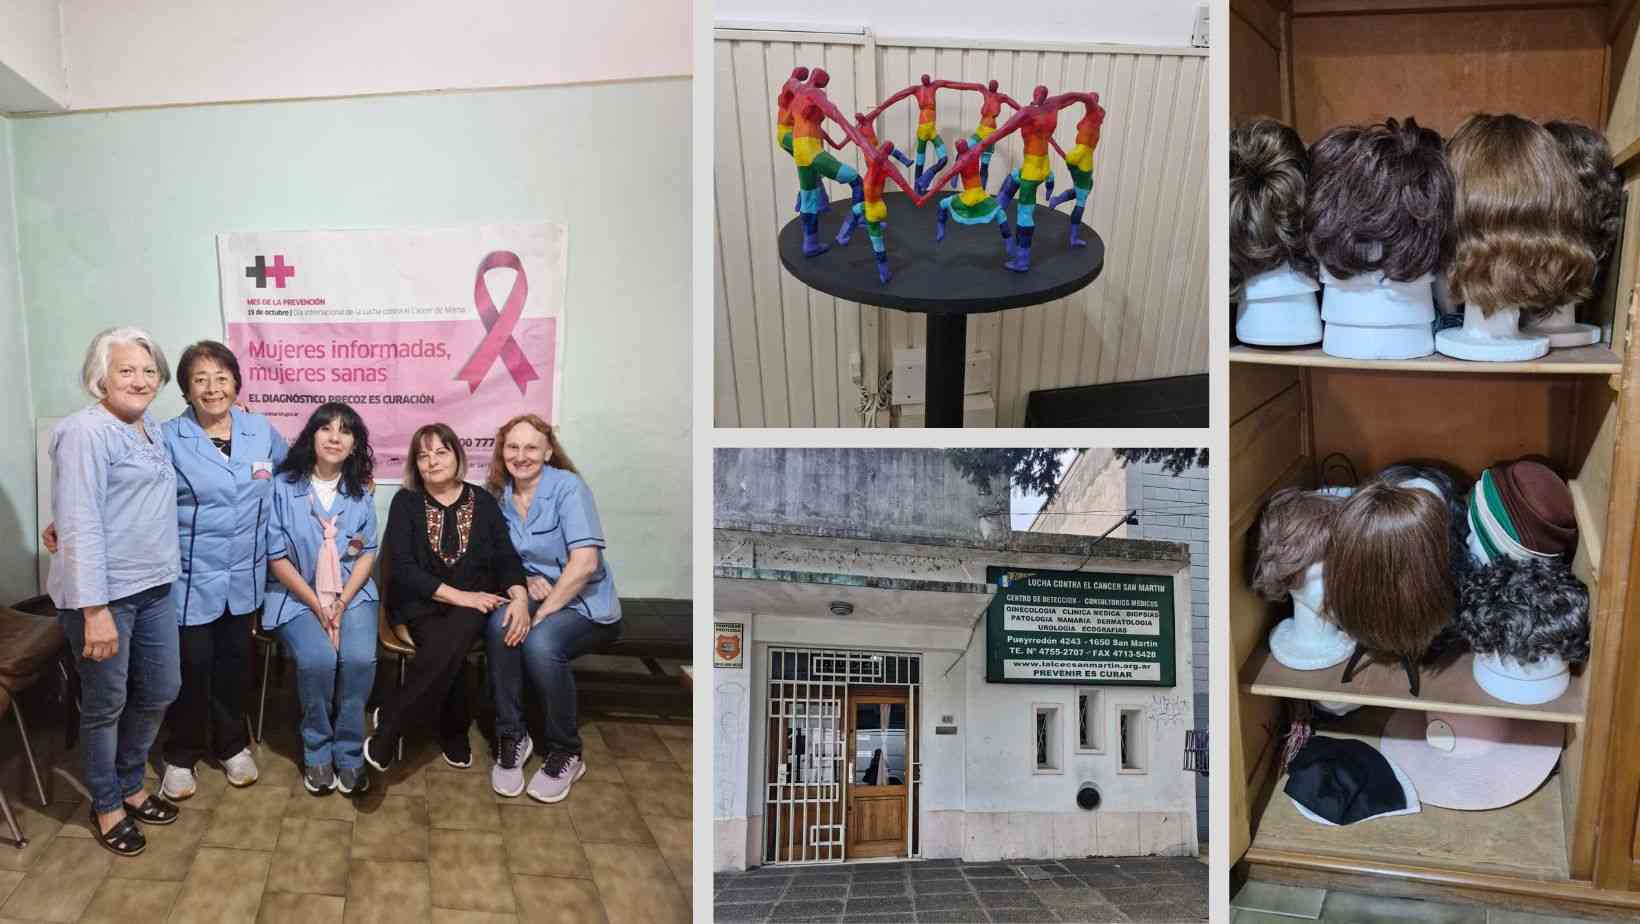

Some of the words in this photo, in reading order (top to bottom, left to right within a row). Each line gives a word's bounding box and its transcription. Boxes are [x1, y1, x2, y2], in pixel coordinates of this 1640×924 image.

[262, 298, 271, 306] DE
[273, 298, 281, 306] LA
[283, 297, 326, 306] PREVENCIÓN
[248, 339, 326, 361] Mujeres
[331, 338, 451, 360] informadas,
[249, 363, 326, 384] mujeres
[331, 367, 387, 382] sanas
[248, 394, 259, 403] EL
[262, 393, 326, 404] DIAGNÓSTICO
[369, 395, 381, 405] ES
[382, 393, 435, 404] CURACIÓN
[474, 438, 495, 448] 777
[1028, 578, 1052, 587] LUCHA
[1053, 579, 1081, 589] CONTRA
[1083, 581, 1092, 590] EL
[1122, 583, 1137, 591] SAN
[1006, 594, 1032, 602] CENTRO
[1006, 606, 1057, 615] GINECOLOGIA
[1062, 608, 1091, 616] CLINICA
[1011, 615, 1053, 623] PATOLOGIA
[1097, 618, 1153, 626] DERMATOLOGIA
[1060, 637, 1081, 645] 4243
[1089, 638, 1111, 646] 1650
[1112, 638, 1129, 647] San
[1038, 648, 1084, 656] 4755-2707
[1092, 649, 1111, 657] FAX
[1112, 649, 1157, 658] 4713-5428
[1033, 669, 1082, 677] PREVENIR
